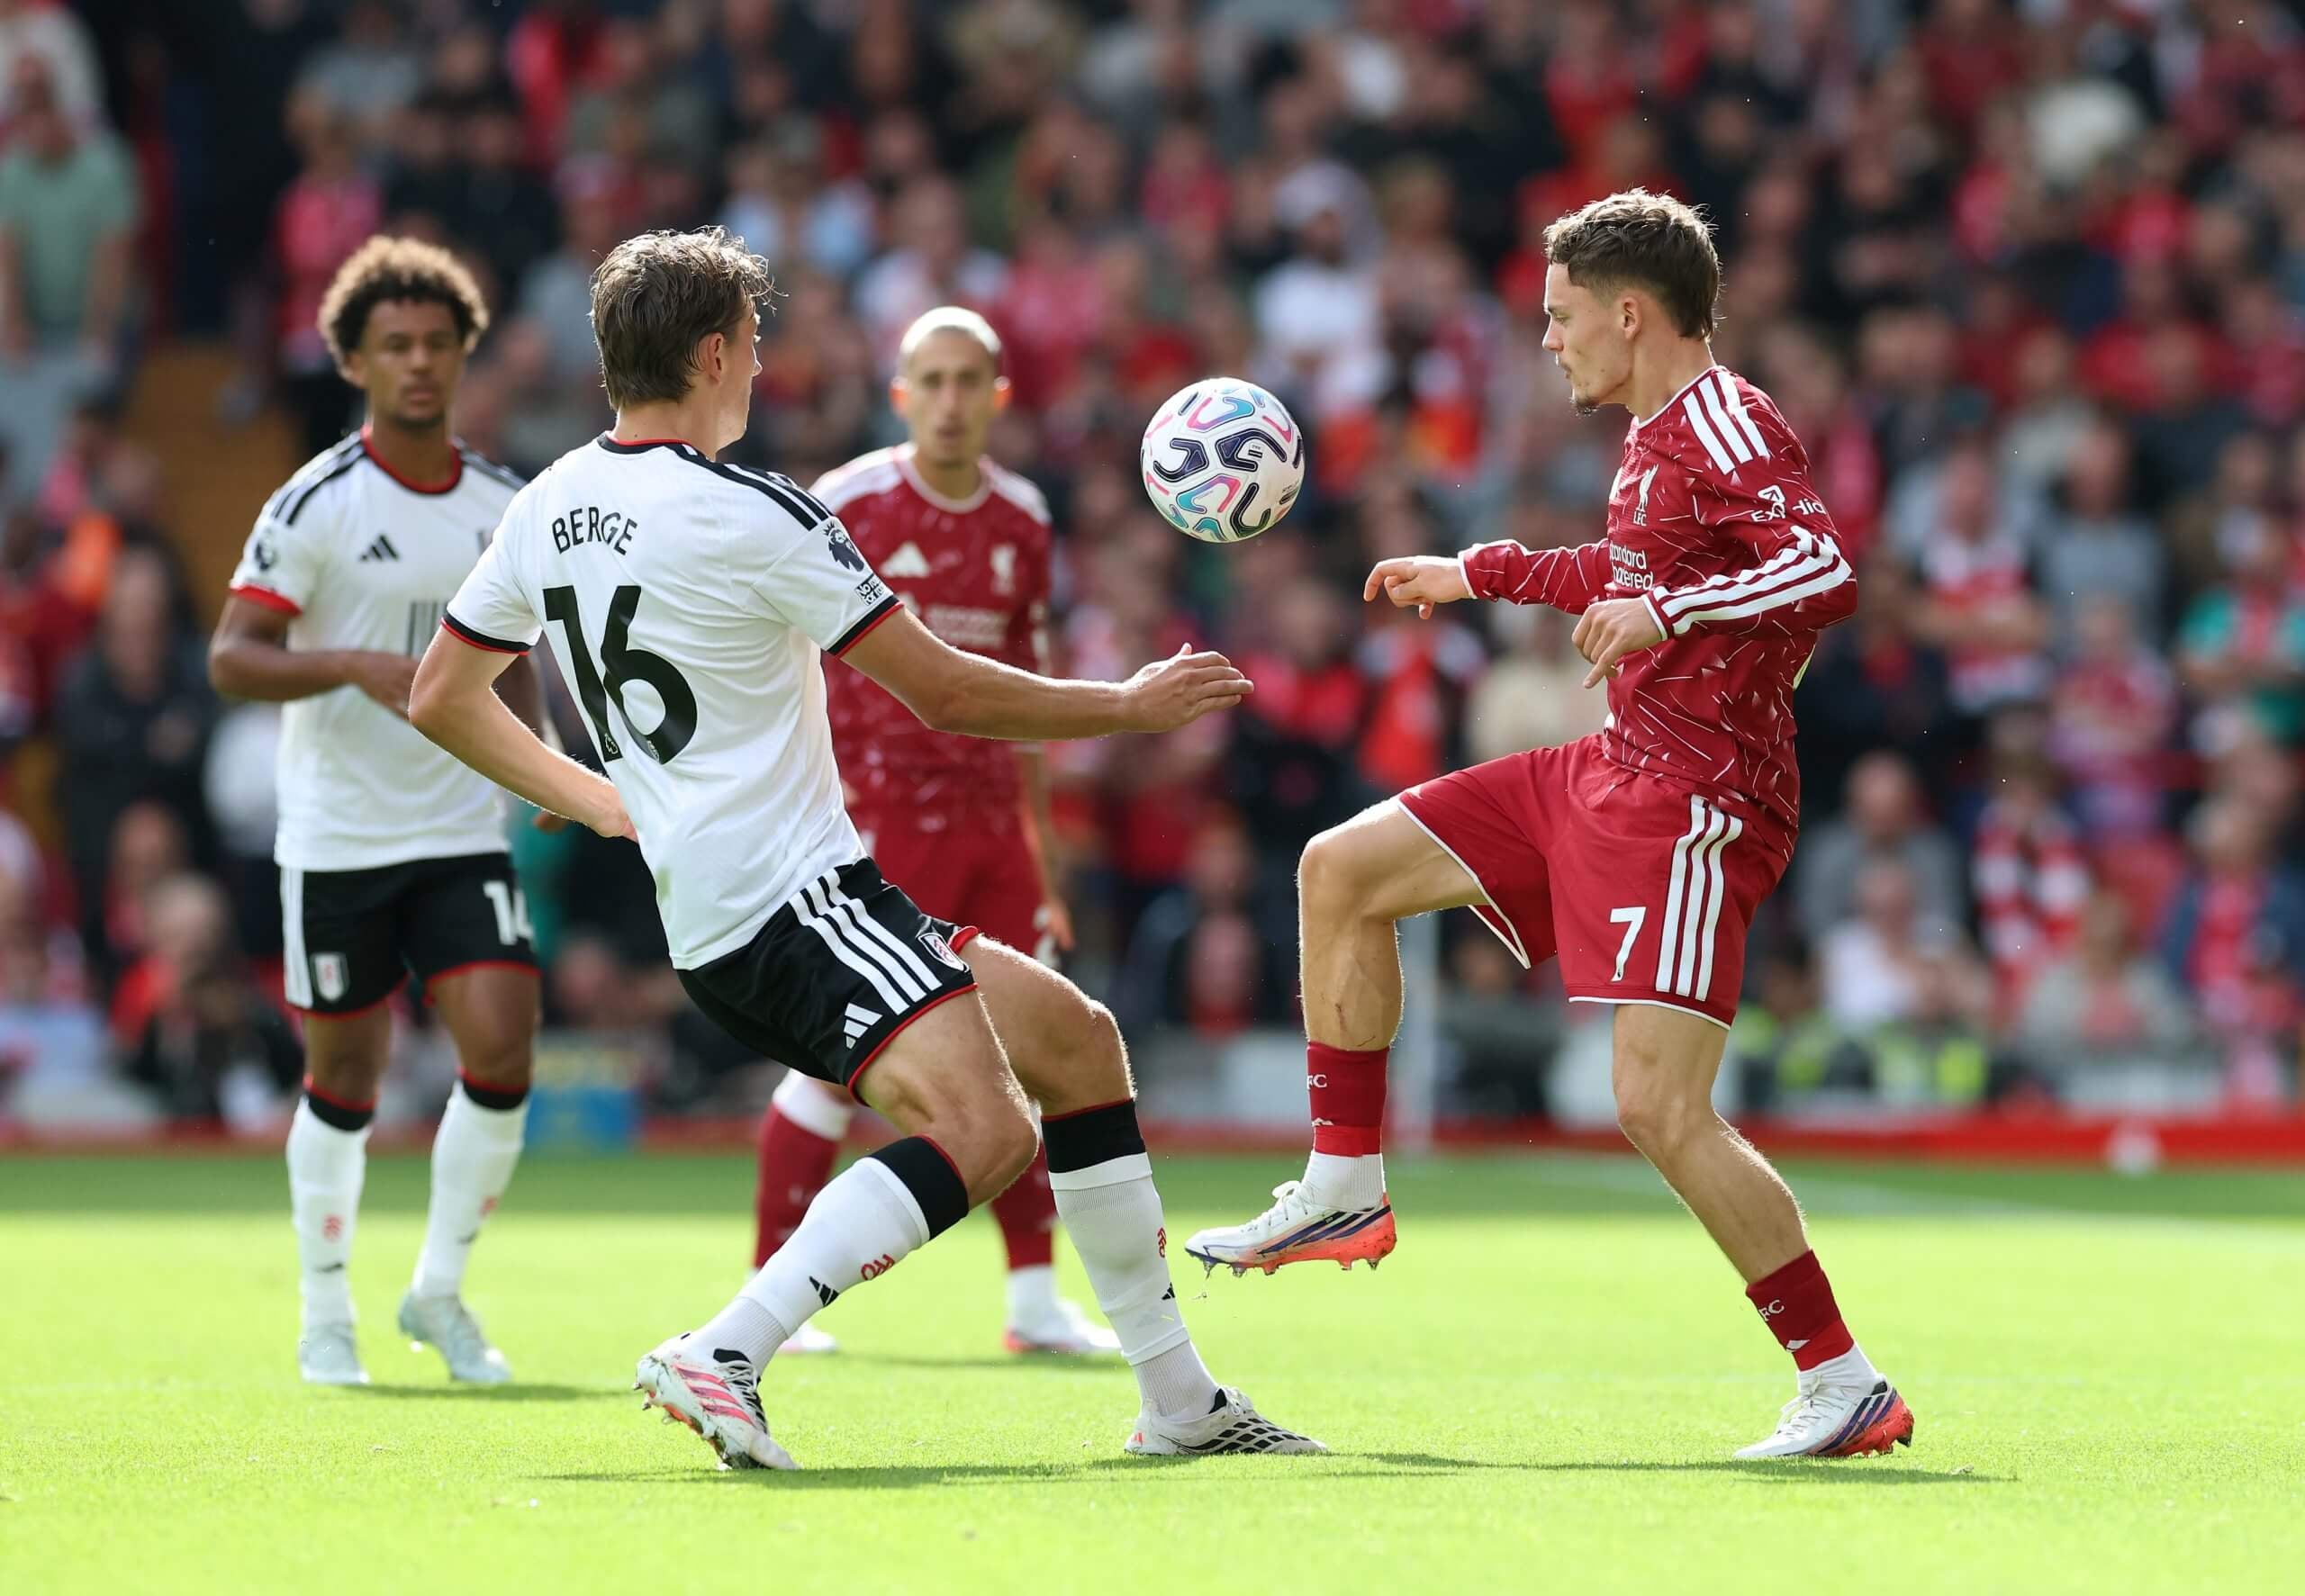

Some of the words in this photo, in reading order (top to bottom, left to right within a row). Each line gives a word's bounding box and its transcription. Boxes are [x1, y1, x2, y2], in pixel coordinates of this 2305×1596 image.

[551, 506, 638, 555] BERGE
[1610, 540, 1647, 570] tandard
[1611, 561, 1654, 591] hartered
[542, 585, 698, 765] 16
[1610, 906, 1647, 982] 7
[1306, 1074, 1328, 1090] FC
[1758, 1299, 1785, 1322] FC
